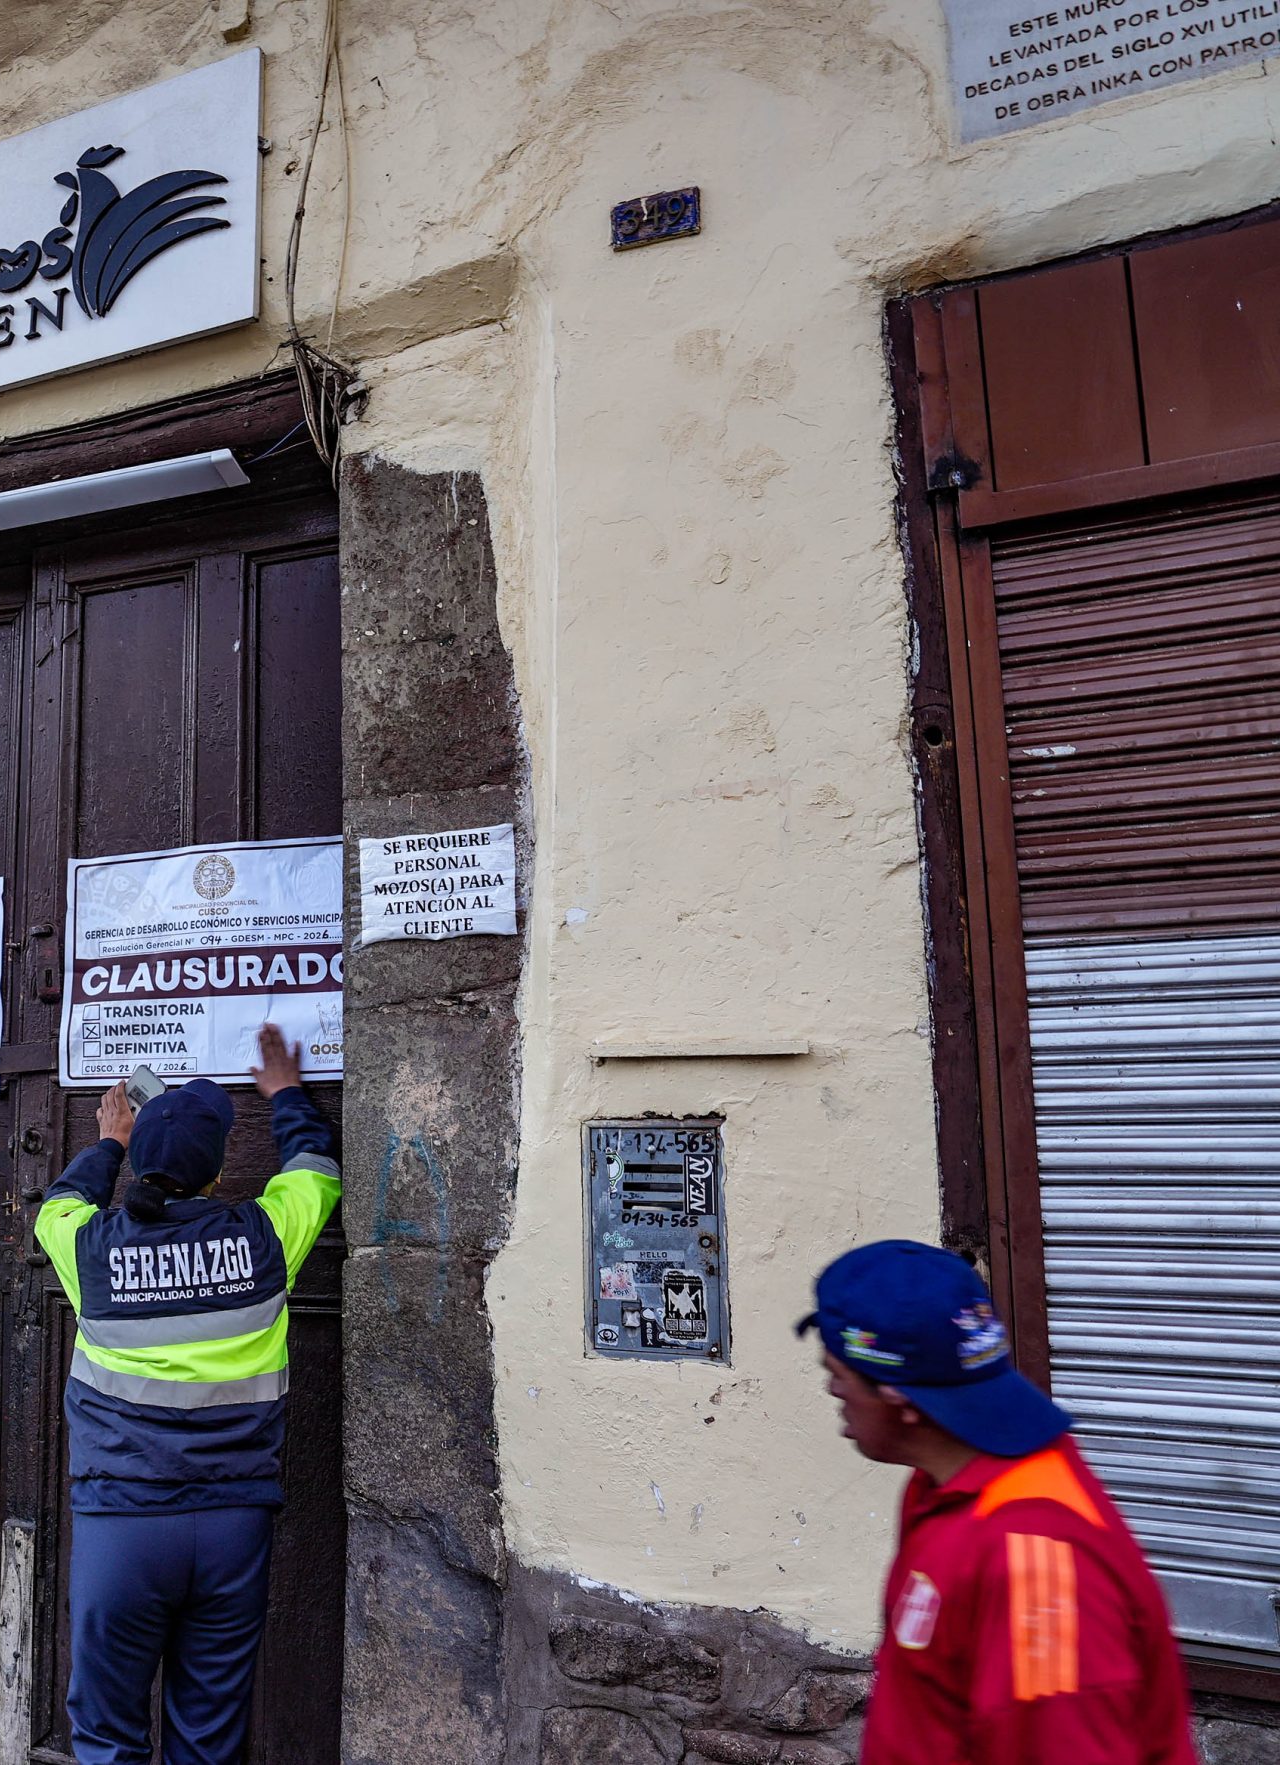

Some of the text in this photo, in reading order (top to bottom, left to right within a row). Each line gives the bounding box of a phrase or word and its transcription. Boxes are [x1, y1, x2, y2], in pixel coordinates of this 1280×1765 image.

[989, 0, 1210, 67] LEVANTADA POR LOS
[1009, 13, 1059, 37] ESTE
[965, 63, 1059, 99] DECADAS
[1064, 52, 1104, 73] DEL
[1111, 31, 1175, 59] SIGLO
[1181, 19, 1214, 40] XVI
[995, 28, 1280, 120] DE OBRA INKA CON PATRO
[620, 196, 685, 236] 349
[383, 832, 491, 855] SE REQUIERE
[394, 854, 481, 875] PERSONAL
[374, 873, 505, 896] MOZOS(A) PARA
[198, 907, 229, 916] CUSCO
[384, 895, 494, 916] ATENCIÓN AL
[85, 928, 124, 940] GERENCIA
[125, 926, 135, 936] DE
[137, 921, 188, 935] DESARROLLO
[190, 916, 242, 929] ECONÓMICO
[244, 917, 250, 926] Y
[252, 915, 300, 926] SERVICIOS
[404, 918, 474, 935] CLIENTE
[102, 943, 144, 953] Resolución
[146, 939, 183, 950] Gerencial
[231, 934, 265, 943] GDESM
[273, 933, 295, 941] MPC
[103, 1003, 205, 1018] TRANSITORIA
[103, 1023, 185, 1037] INMEDIATA
[104, 1041, 188, 1056] DEFINITIVA
[622, 1212, 699, 1228] 01-34-565
[109, 1236, 254, 1290] SERENAZGO
[640, 1251, 668, 1259] HELLO
[110, 1281, 255, 1303] MUNICIPALIDAD DE CUSCO
